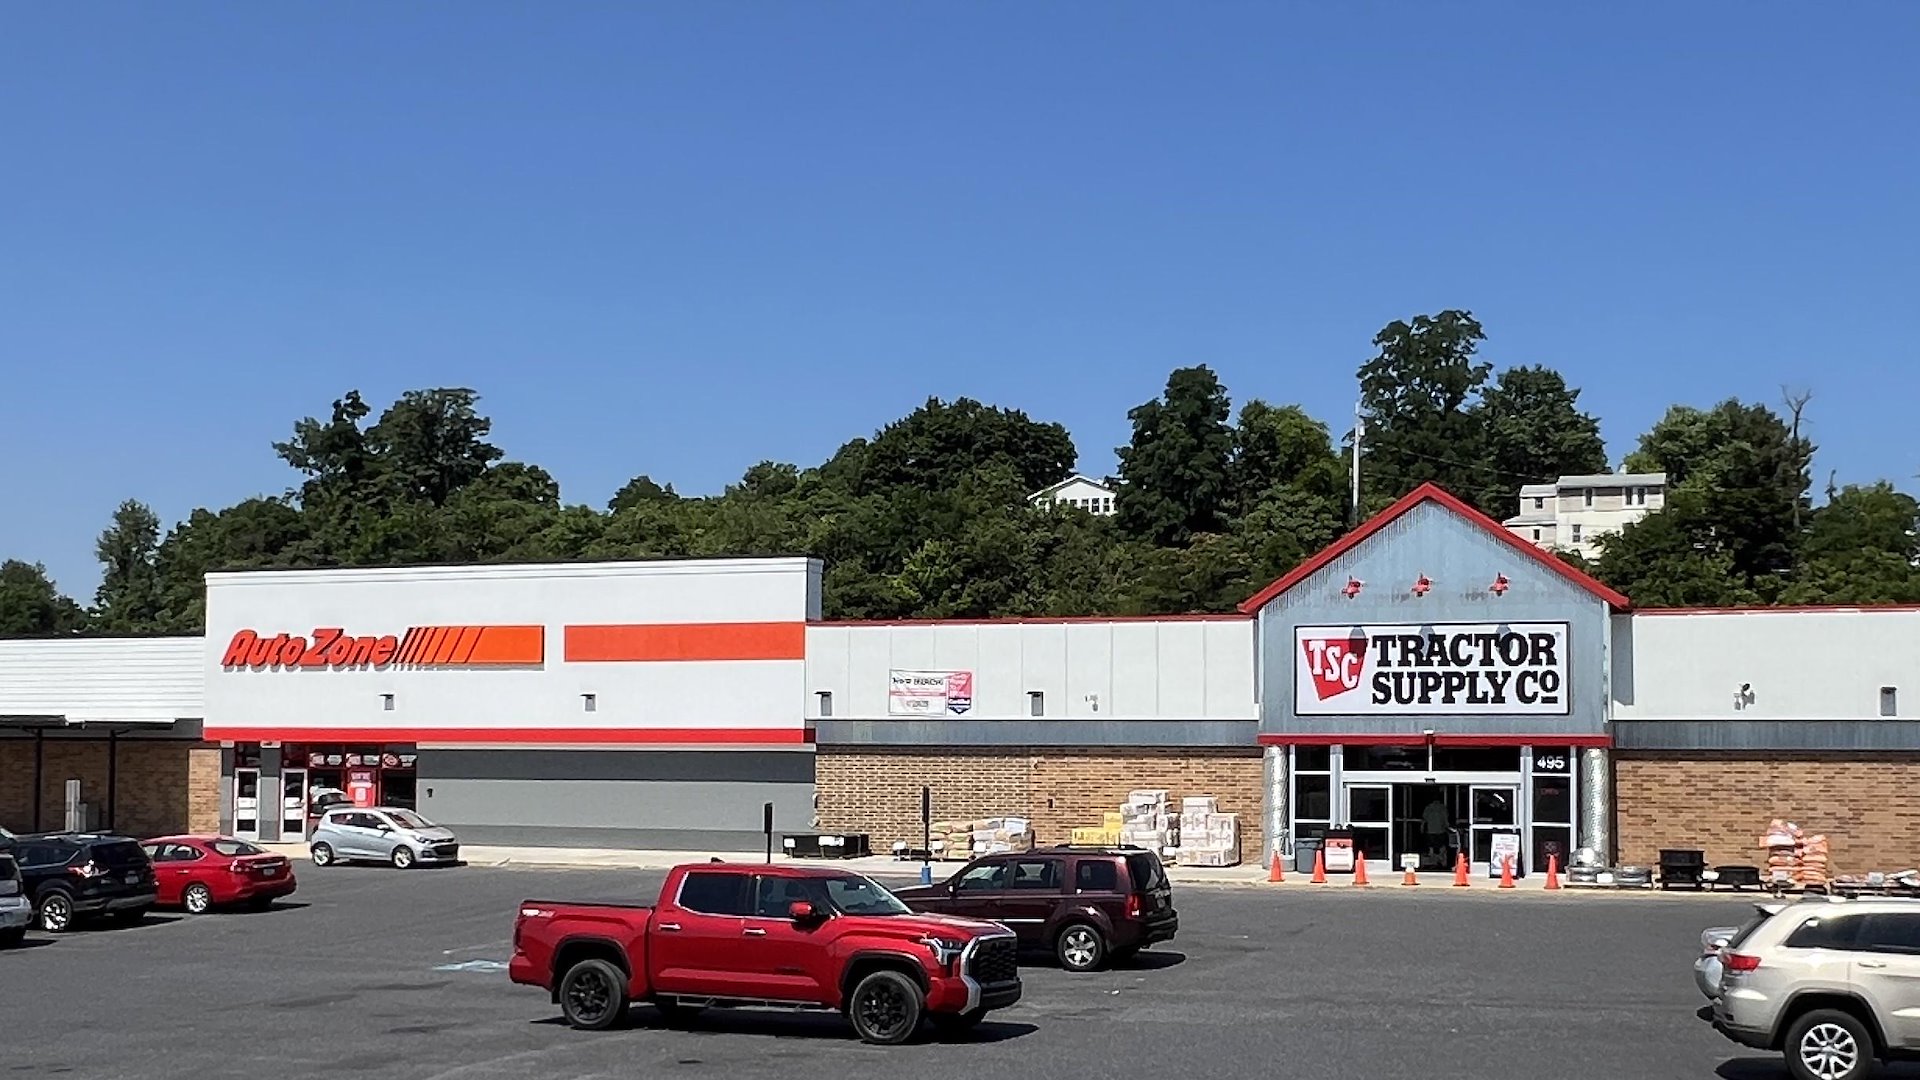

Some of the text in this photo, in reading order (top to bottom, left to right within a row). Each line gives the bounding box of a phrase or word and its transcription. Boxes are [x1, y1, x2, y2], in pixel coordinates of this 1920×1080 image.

[221, 628, 398, 667] AutoZone
[1308, 639, 1358, 689] TSC
[1372, 632, 1557, 667] TRACTOR
[1372, 671, 1511, 704] SUPPLY
[1537, 755, 1566, 769] 495
